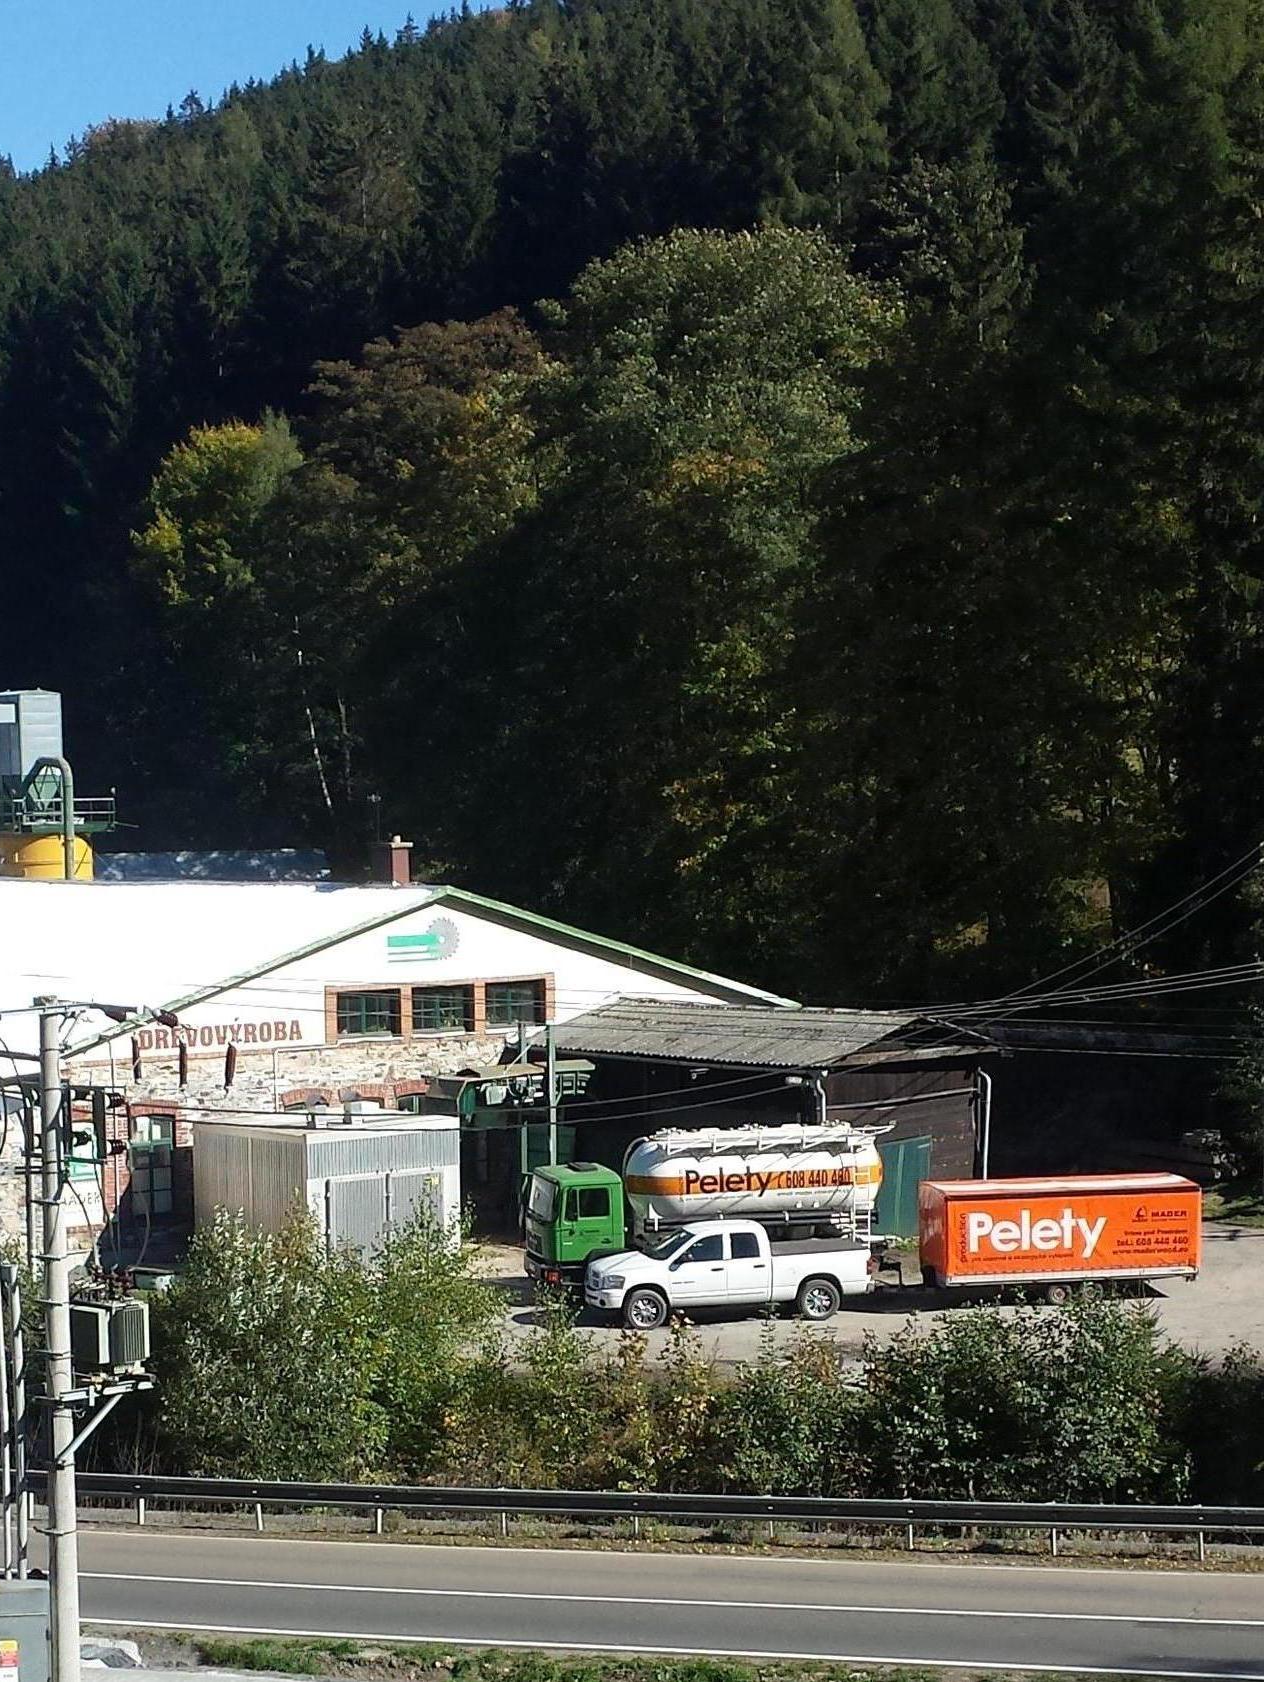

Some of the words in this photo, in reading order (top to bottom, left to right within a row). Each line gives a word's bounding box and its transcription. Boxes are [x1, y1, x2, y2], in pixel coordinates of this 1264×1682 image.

[685, 1166, 772, 1197] Pelety
[786, 1171, 805, 1188] 608
[808, 1169, 828, 1187] 440
[968, 1207, 1107, 1259] Pelety
